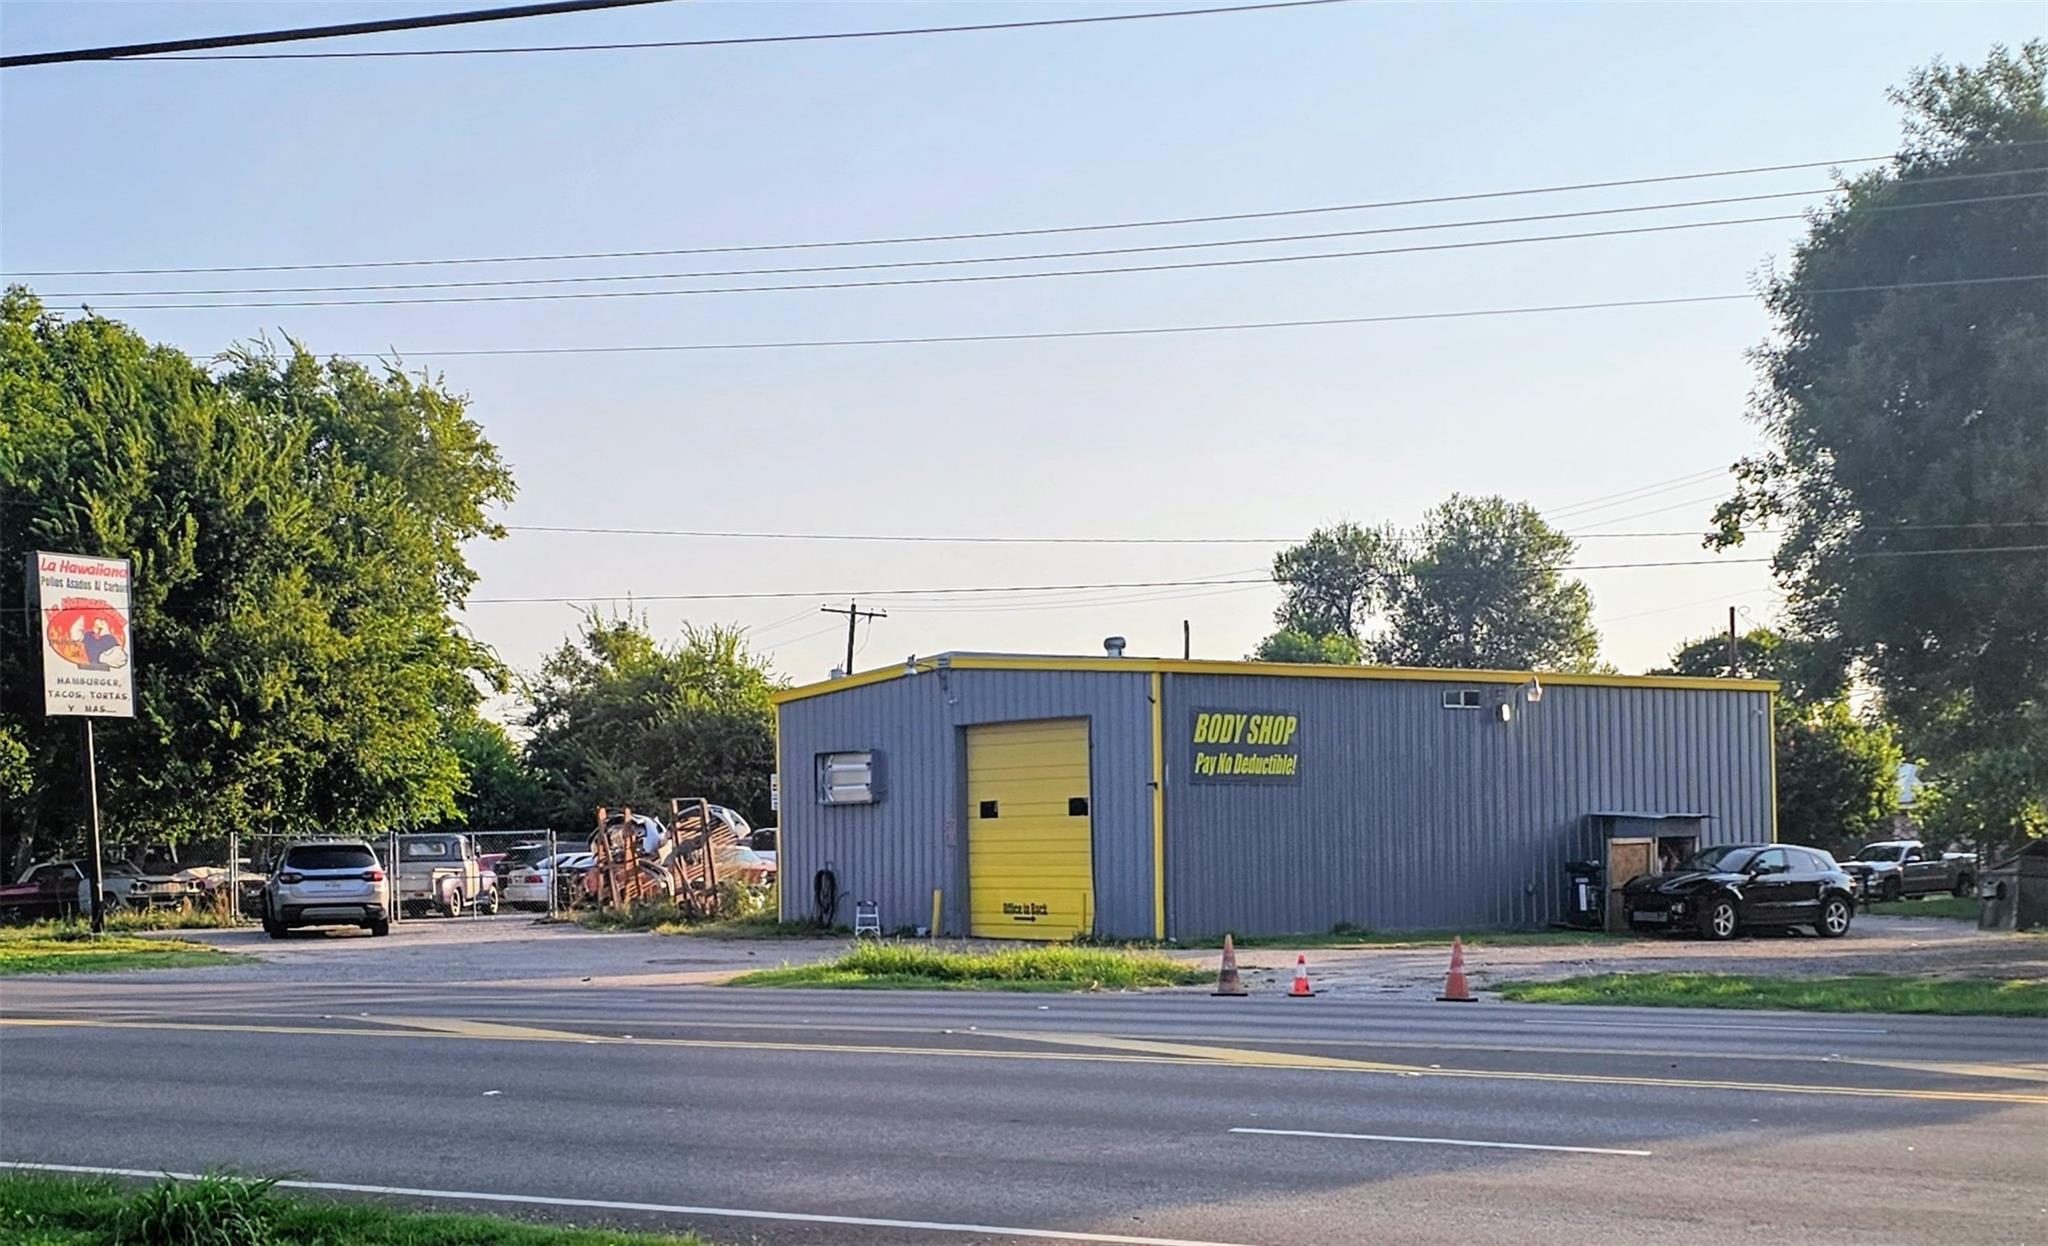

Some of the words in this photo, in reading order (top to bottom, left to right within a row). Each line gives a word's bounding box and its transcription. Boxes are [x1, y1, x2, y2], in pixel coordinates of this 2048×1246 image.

[41, 557, 57, 572] La
[57, 677, 122, 687] HAMBURGER,
[90, 691, 128, 701] TORTAS
[68, 704, 75, 712] Y
[1193, 713, 1248, 744] BODY
[1246, 714, 1298, 745] SHOP
[1195, 752, 1218, 776] Pay
[1217, 752, 1233, 774] No
[1233, 753, 1298, 775] Deductible!
[1003, 902, 1022, 914] Office
